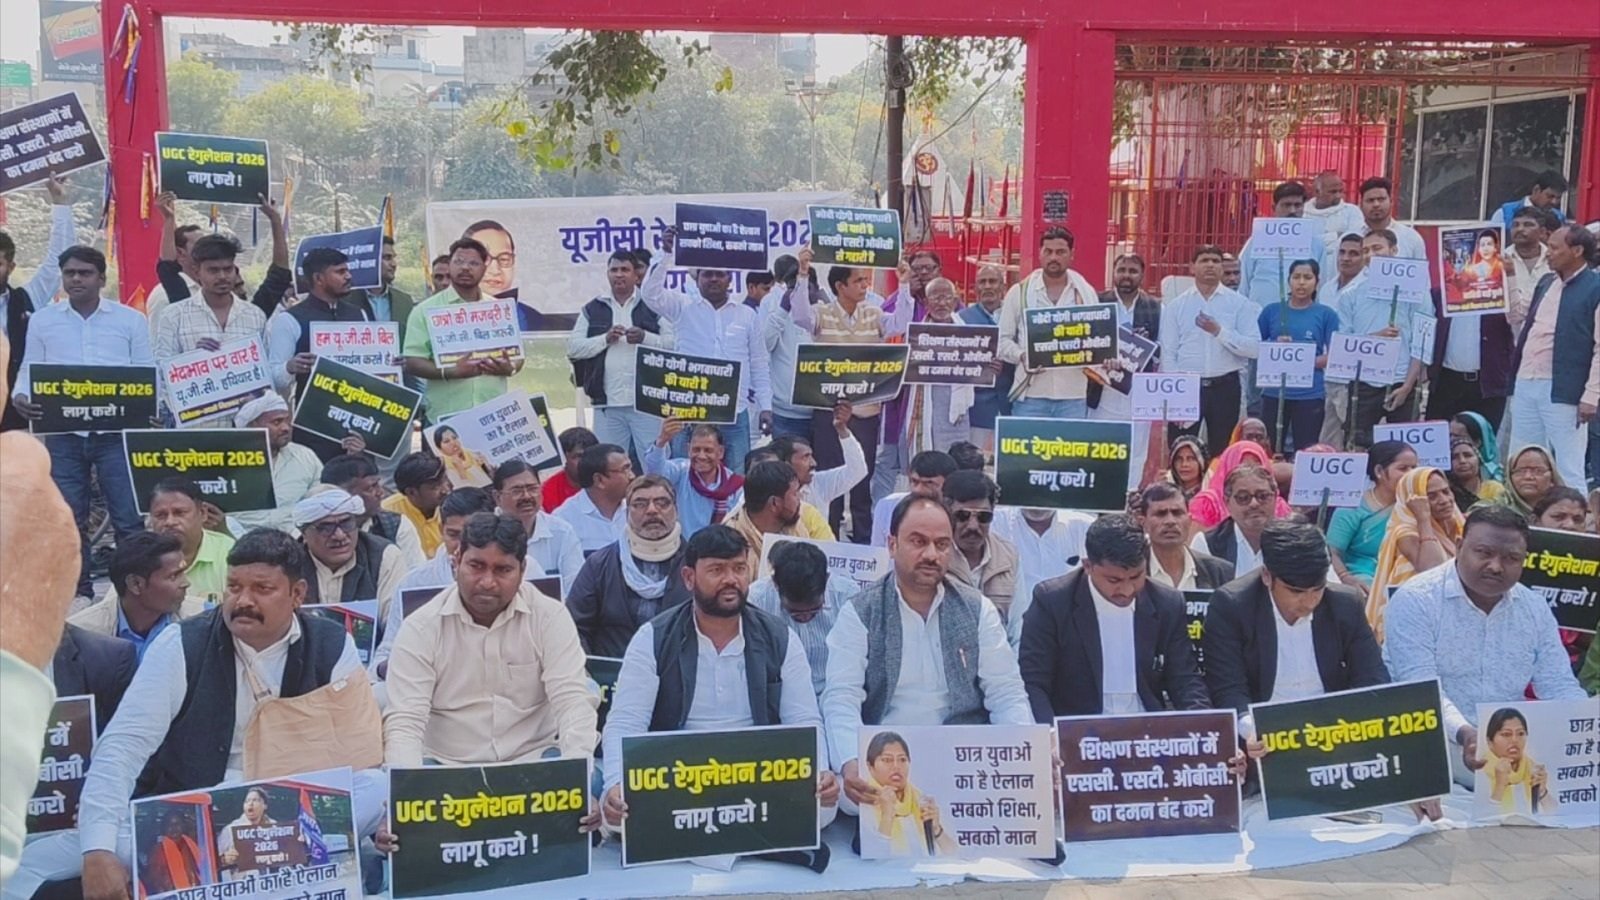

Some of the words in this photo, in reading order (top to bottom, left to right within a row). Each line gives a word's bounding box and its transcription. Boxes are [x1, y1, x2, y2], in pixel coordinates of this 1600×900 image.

[162, 147, 186, 160] UGC
[187, 146, 234, 165] रेगुलेशन
[236, 153, 265, 166] 2026
[187, 171, 214, 188] लागू
[213, 171, 235, 186] करो
[238, 174, 242, 187] !
[1265, 222, 1302, 236] UGC
[559, 217, 645, 263] यूजीसी
[769, 220, 809, 247] 202
[1381, 262, 1417, 278] UGC
[1270, 347, 1305, 362] UGC
[1344, 338, 1386, 356] UGC
[168, 360, 210, 383] भेदभाव
[211, 354, 228, 370] पर
[228, 348, 249, 366] वार
[248, 340, 259, 362] है
[800, 361, 822, 373] UGC
[824, 358, 872, 377] रेगुलेशन
[873, 361, 903, 373] 2026
[33, 382, 60, 395] UGC
[61, 379, 117, 399] रेगुलेशन
[119, 383, 154, 396] 2026
[820, 382, 846, 398] लागू
[845, 380, 869, 394] करो
[870, 382, 875, 393] !
[1146, 378, 1186, 393] UGC
[312, 373, 338, 393] UGC
[337, 379, 384, 410] रेगुलेशन
[382, 400, 411, 421] 2026
[61, 405, 93, 421] लागू
[91, 403, 117, 417] करो
[121, 406, 125, 416] !
[327, 405, 353, 429] लागू
[351, 416, 375, 432] करो
[373, 422, 381, 435] !
[1390, 427, 1434, 444] UGC
[1001, 438, 1029, 454] UGC
[1031, 435, 1089, 461] रेगुलेशन
[1091, 442, 1127, 460] 2026
[132, 452, 162, 467] UGC
[163, 448, 224, 472] रेगुलेशन
[227, 451, 266, 466] 2026
[1310, 457, 1354, 475] UGC
[198, 476, 228, 494] करो
[231, 479, 238, 494] !
[1028, 469, 1061, 491] लागू
[1059, 468, 1087, 487] करो
[1090, 473, 1095, 488] !
[829, 556, 847, 568] छात्र
[1540, 549, 1599, 576] रेगुलेशन
[1559, 586, 1589, 605] करो
[1588, 592, 1597, 606] !
[47, 721, 72, 747] में
[1262, 729, 1301, 752] UGC
[1302, 719, 1384, 752] रेगुलेशन
[1388, 709, 1438, 737] 2026
[1569, 718, 1595, 733] छात्र
[954, 747, 983, 762] छात्र
[1079, 736, 1133, 760] शिक्षण
[1133, 733, 1200, 758] संस्थानों
[1201, 731, 1220, 755] में
[1565, 742, 1583, 757] का
[1585, 738, 1595, 755] है
[628, 767, 670, 791] UGC
[672, 757, 757, 795] रेगुलेशन
[760, 757, 812, 782] 2026
[954, 774, 974, 790] का
[976, 769, 988, 790] है
[991, 769, 1035, 790] ऐलान
[1065, 768, 1119, 793] एससी.
[1121, 765, 1169, 790] एसटी.
[1173, 762, 1234, 788] ओबीसी.
[1307, 763, 1355, 790] लागू
[1350, 753, 1389, 781] करो
[1393, 755, 1402, 775] !
[1557, 761, 1595, 780] सबको
[27, 790, 66, 816] करो
[1559, 784, 1597, 804] सबको
[395, 799, 437, 823] UGC
[440, 791, 527, 828] रेगुलेशन
[531, 788, 583, 813] 2026
[671, 807, 720, 834] लागू
[716, 798, 757, 826] करो
[761, 802, 768, 822] !
[950, 797, 994, 818] सबको
[999, 797, 1042, 820] शिक्षा,
[1090, 804, 1112, 823] का
[1115, 802, 1155, 821] दमन
[1158, 797, 1180, 819] बंद
[1182, 794, 1215, 818] करो
[254, 840, 279, 852] 2026
[957, 826, 1001, 846] सबको
[1004, 830, 1038, 846] मान
[440, 839, 489, 868] लागू
[486, 830, 527, 860] करो
[532, 833, 539, 854] !
